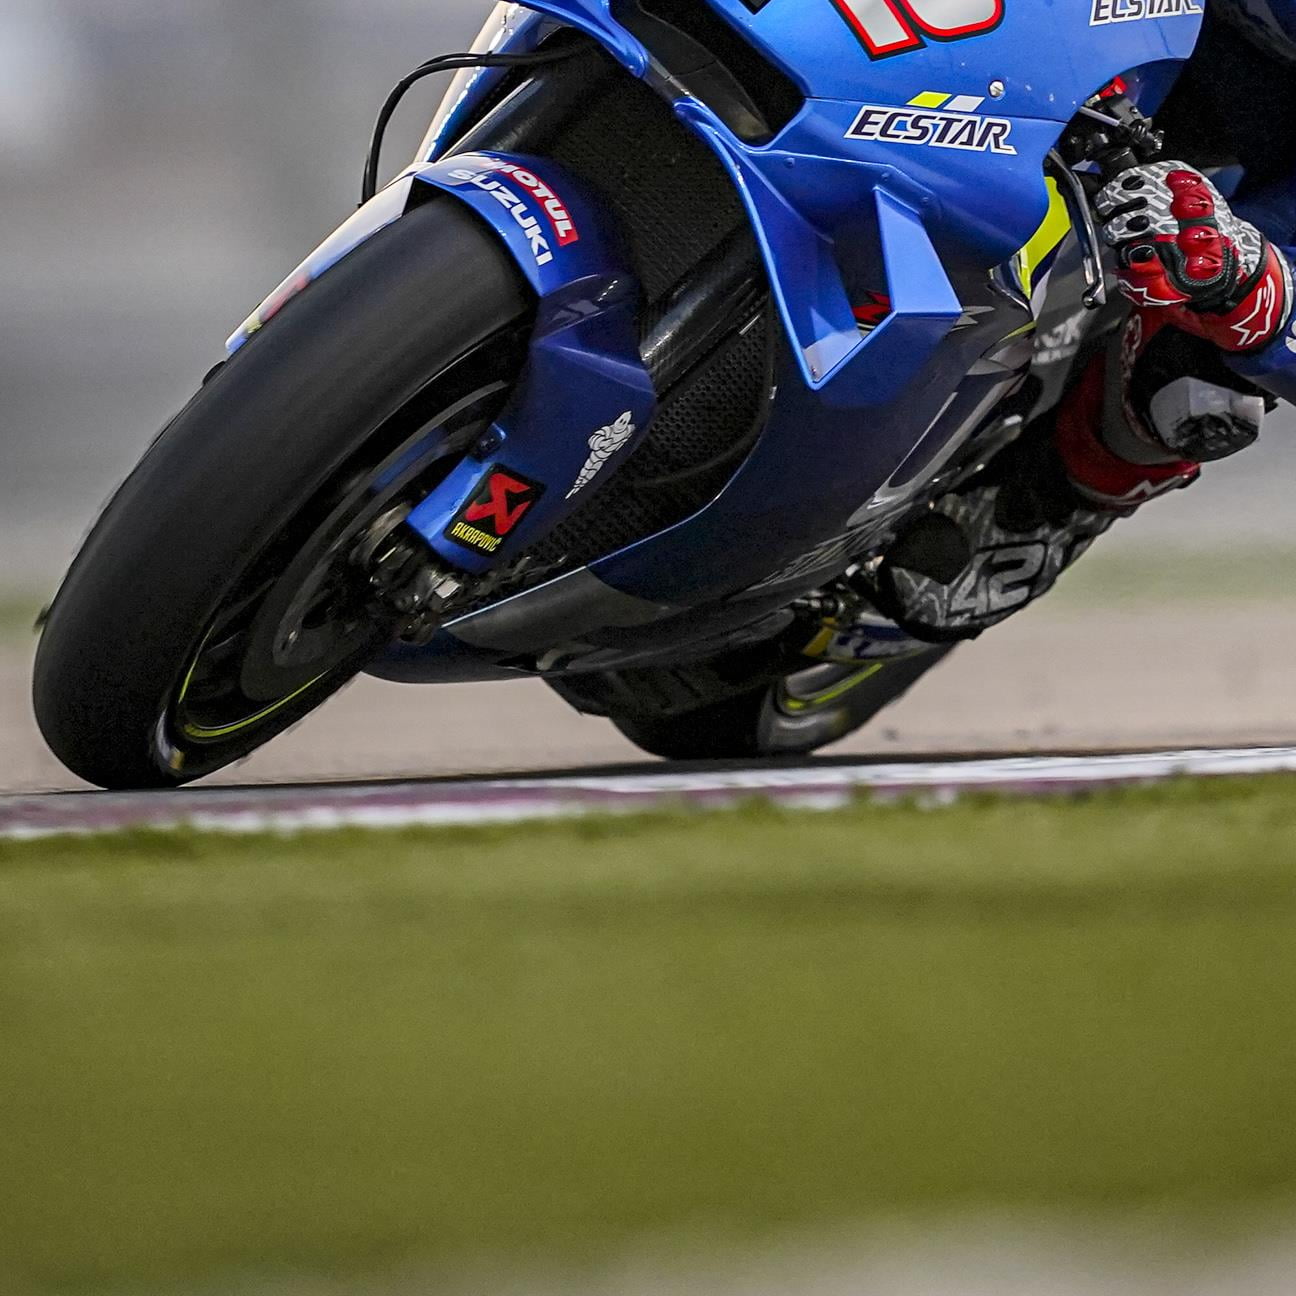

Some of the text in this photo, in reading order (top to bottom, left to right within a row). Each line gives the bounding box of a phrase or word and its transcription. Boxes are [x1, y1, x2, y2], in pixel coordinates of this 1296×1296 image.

[842, 107, 1017, 154] ECSTAR
[448, 169, 553, 266] SUZUKI
[486, 157, 573, 238] MOTUL
